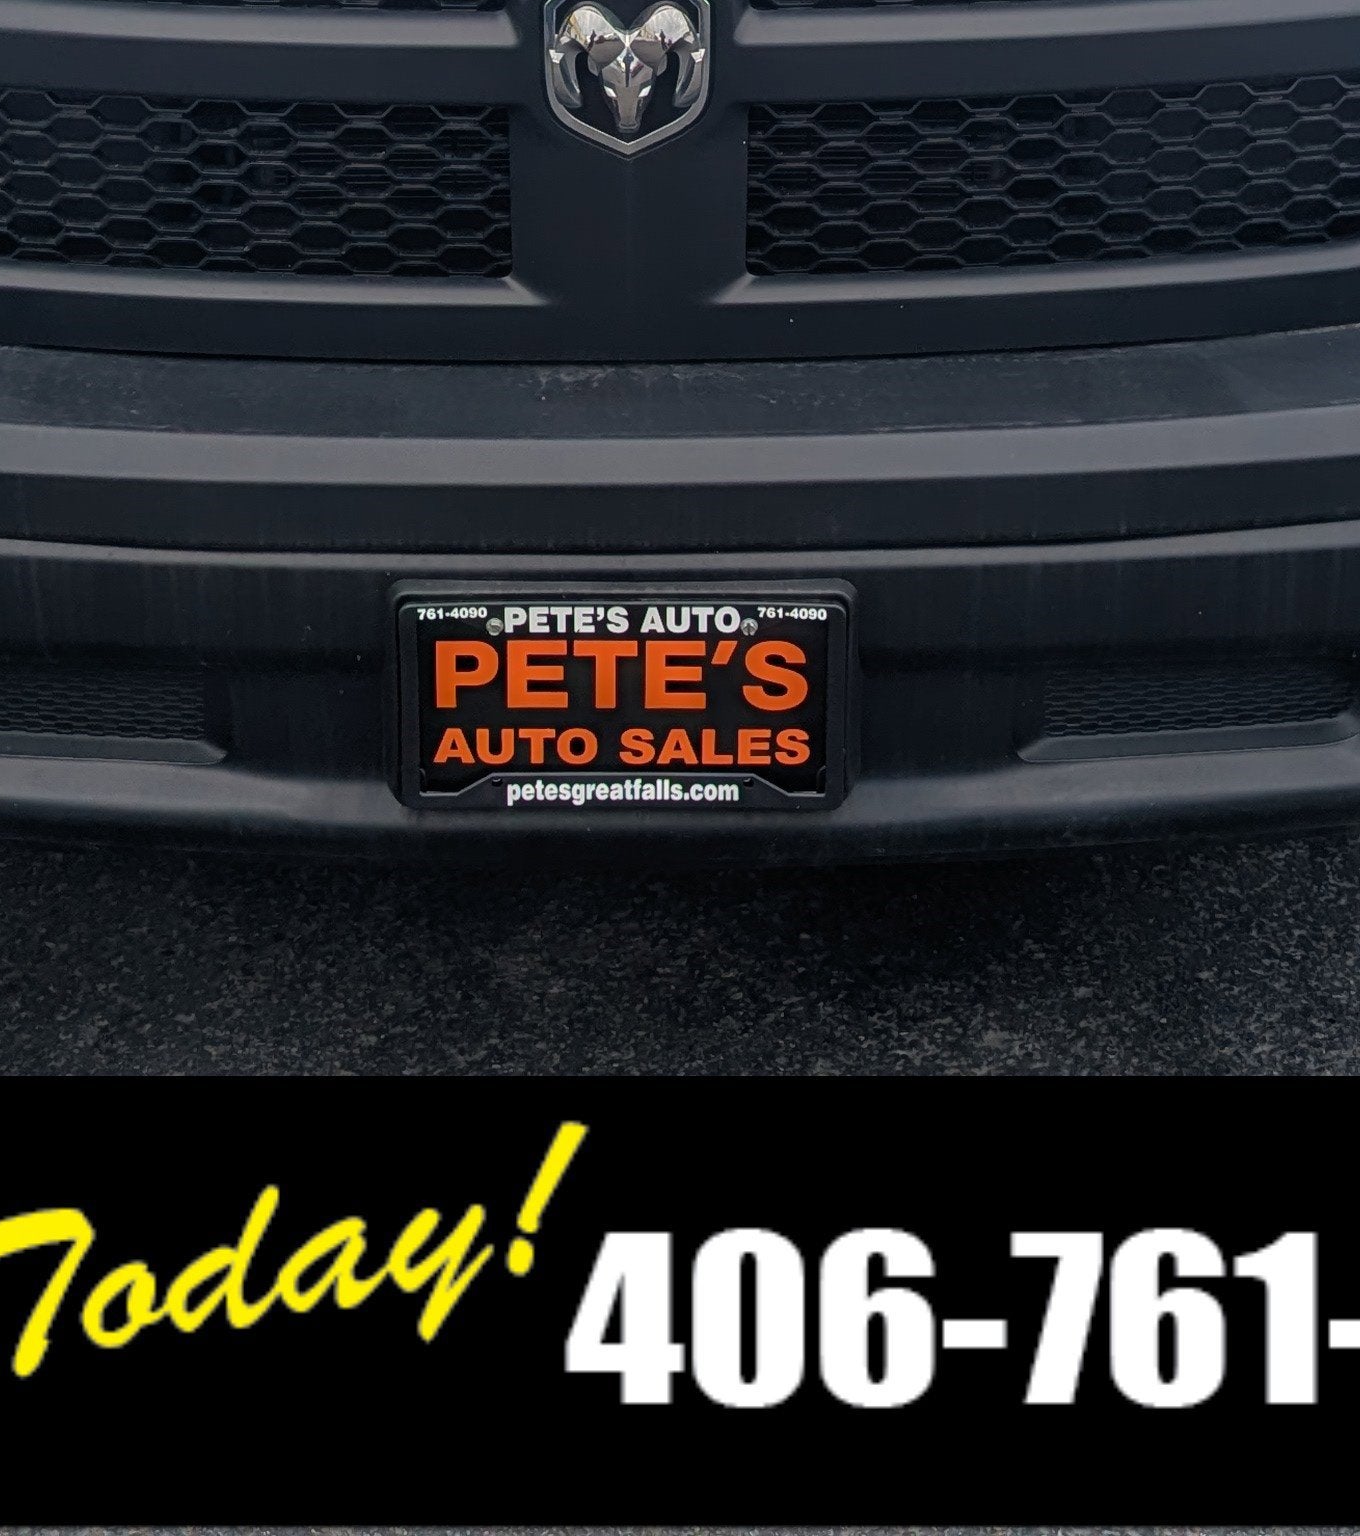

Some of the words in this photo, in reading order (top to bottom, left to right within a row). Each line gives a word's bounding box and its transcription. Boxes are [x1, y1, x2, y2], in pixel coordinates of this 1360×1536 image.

[417, 607, 488, 621] 761-4090
[504, 606, 629, 634] PETE'S
[641, 606, 741, 634] AUTO
[757, 607, 828, 622] 761-4090
[435, 639, 809, 712] PETE'S
[433, 727, 599, 765] AUTO
[619, 727, 810, 766] SALES
[506, 778, 740, 806] petesgreatfalls.com
